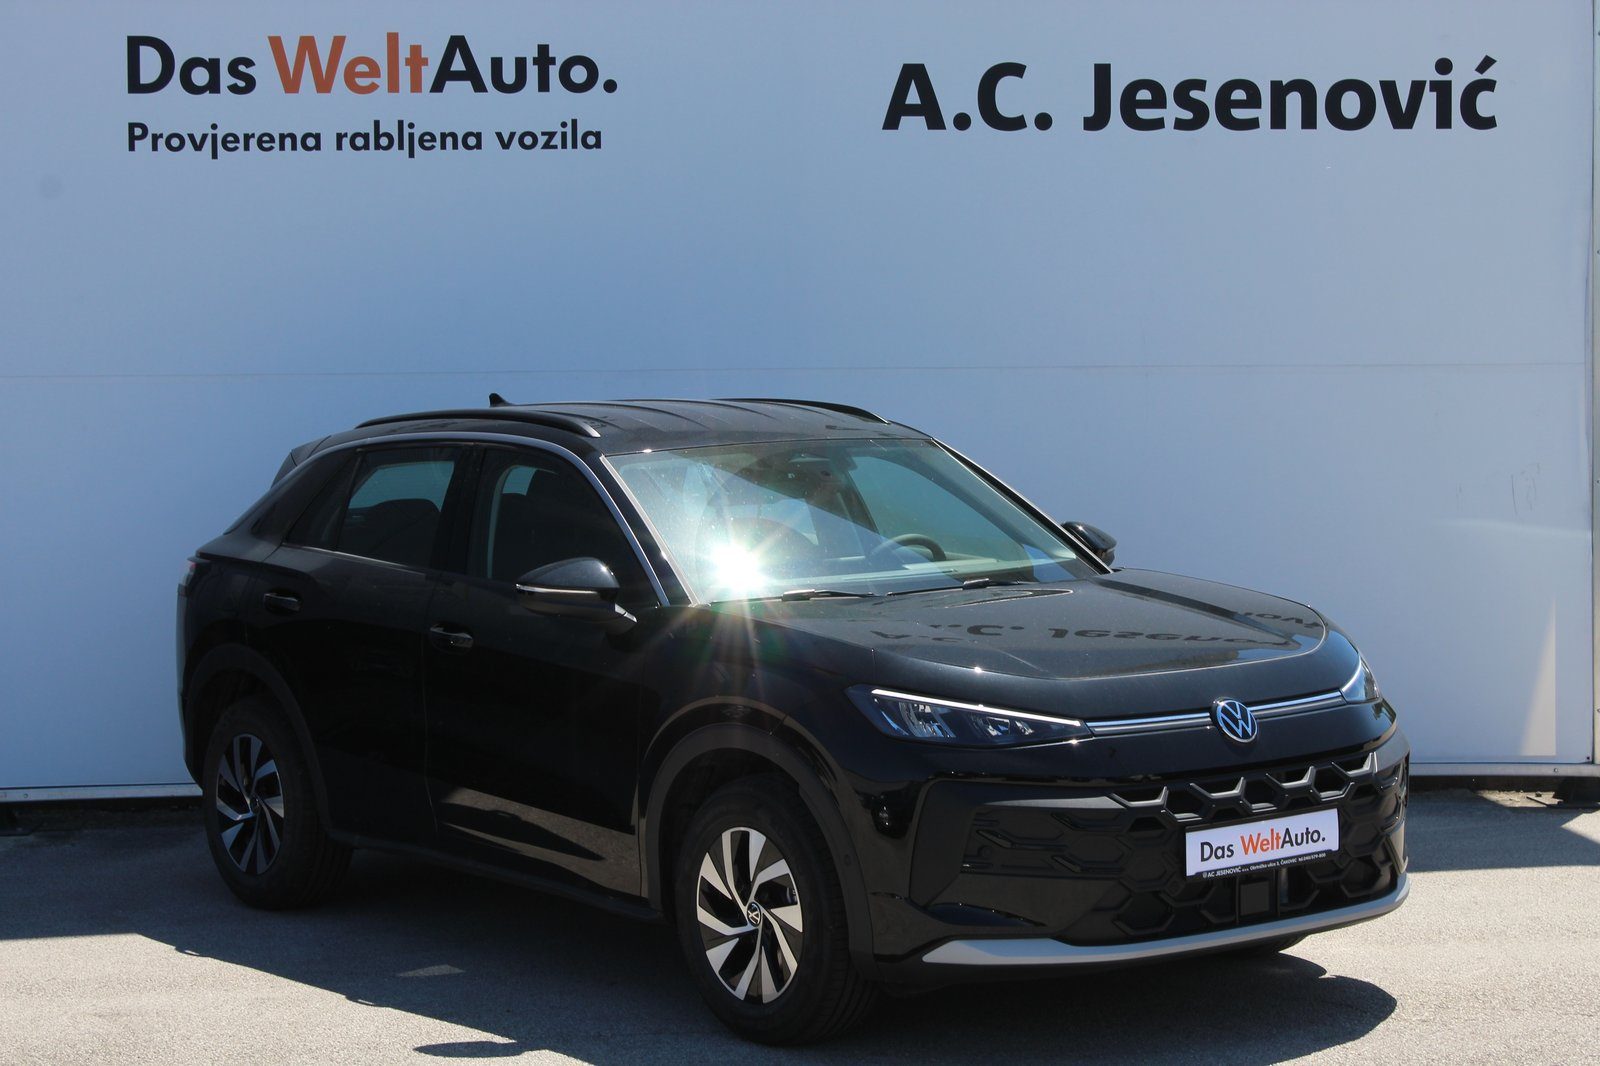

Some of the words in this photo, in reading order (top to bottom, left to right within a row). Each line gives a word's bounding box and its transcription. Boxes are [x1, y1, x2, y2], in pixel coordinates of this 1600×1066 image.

[127, 36, 257, 95] Das
[268, 32, 618, 95] WeltAuto.
[882, 62, 1053, 131] A.C.
[1083, 55, 1497, 132] Jesenović
[127, 122, 322, 160] Provjerena
[336, 120, 483, 159] rabljena
[495, 119, 602, 150] vozila
[1200, 841, 1235, 862] Das
[1240, 827, 1326, 856] WeltAuto.
